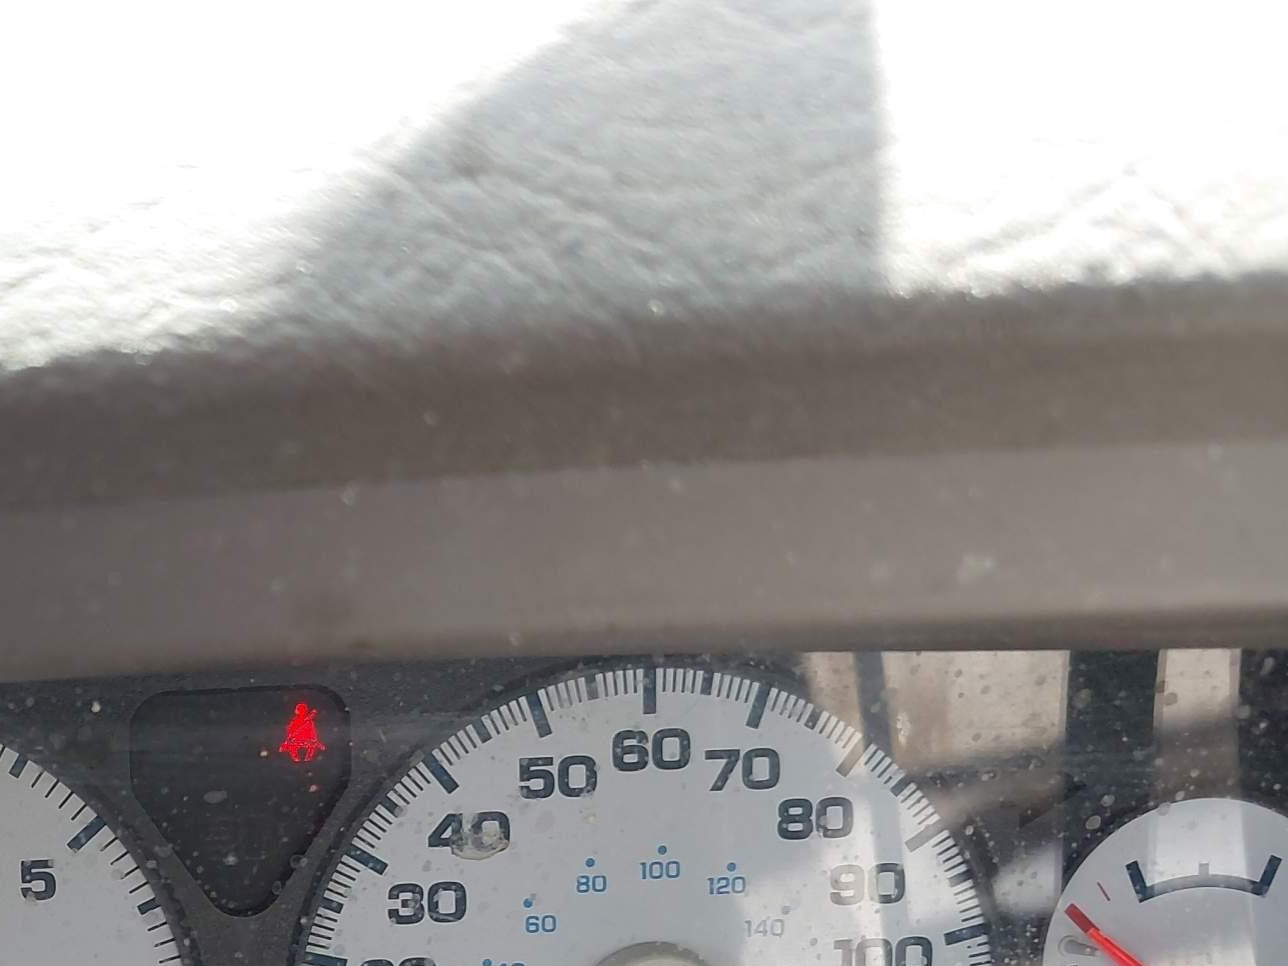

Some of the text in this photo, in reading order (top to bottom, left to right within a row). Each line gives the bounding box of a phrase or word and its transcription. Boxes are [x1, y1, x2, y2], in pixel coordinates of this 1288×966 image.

[612, 728, 690, 772] 60
[704, 748, 780, 791] 70
[519, 755, 597, 799] 50
[427, 811, 510, 849] 40
[777, 797, 853, 840] 80
[20, 859, 56, 900] 5
[576, 875, 607, 893] 80
[640, 861, 680, 880] 100
[707, 876, 746, 895] 120
[830, 863, 905, 905] 90
[388, 881, 467, 924] 30
[525, 915, 556, 933] 60
[745, 919, 784, 937] 140
